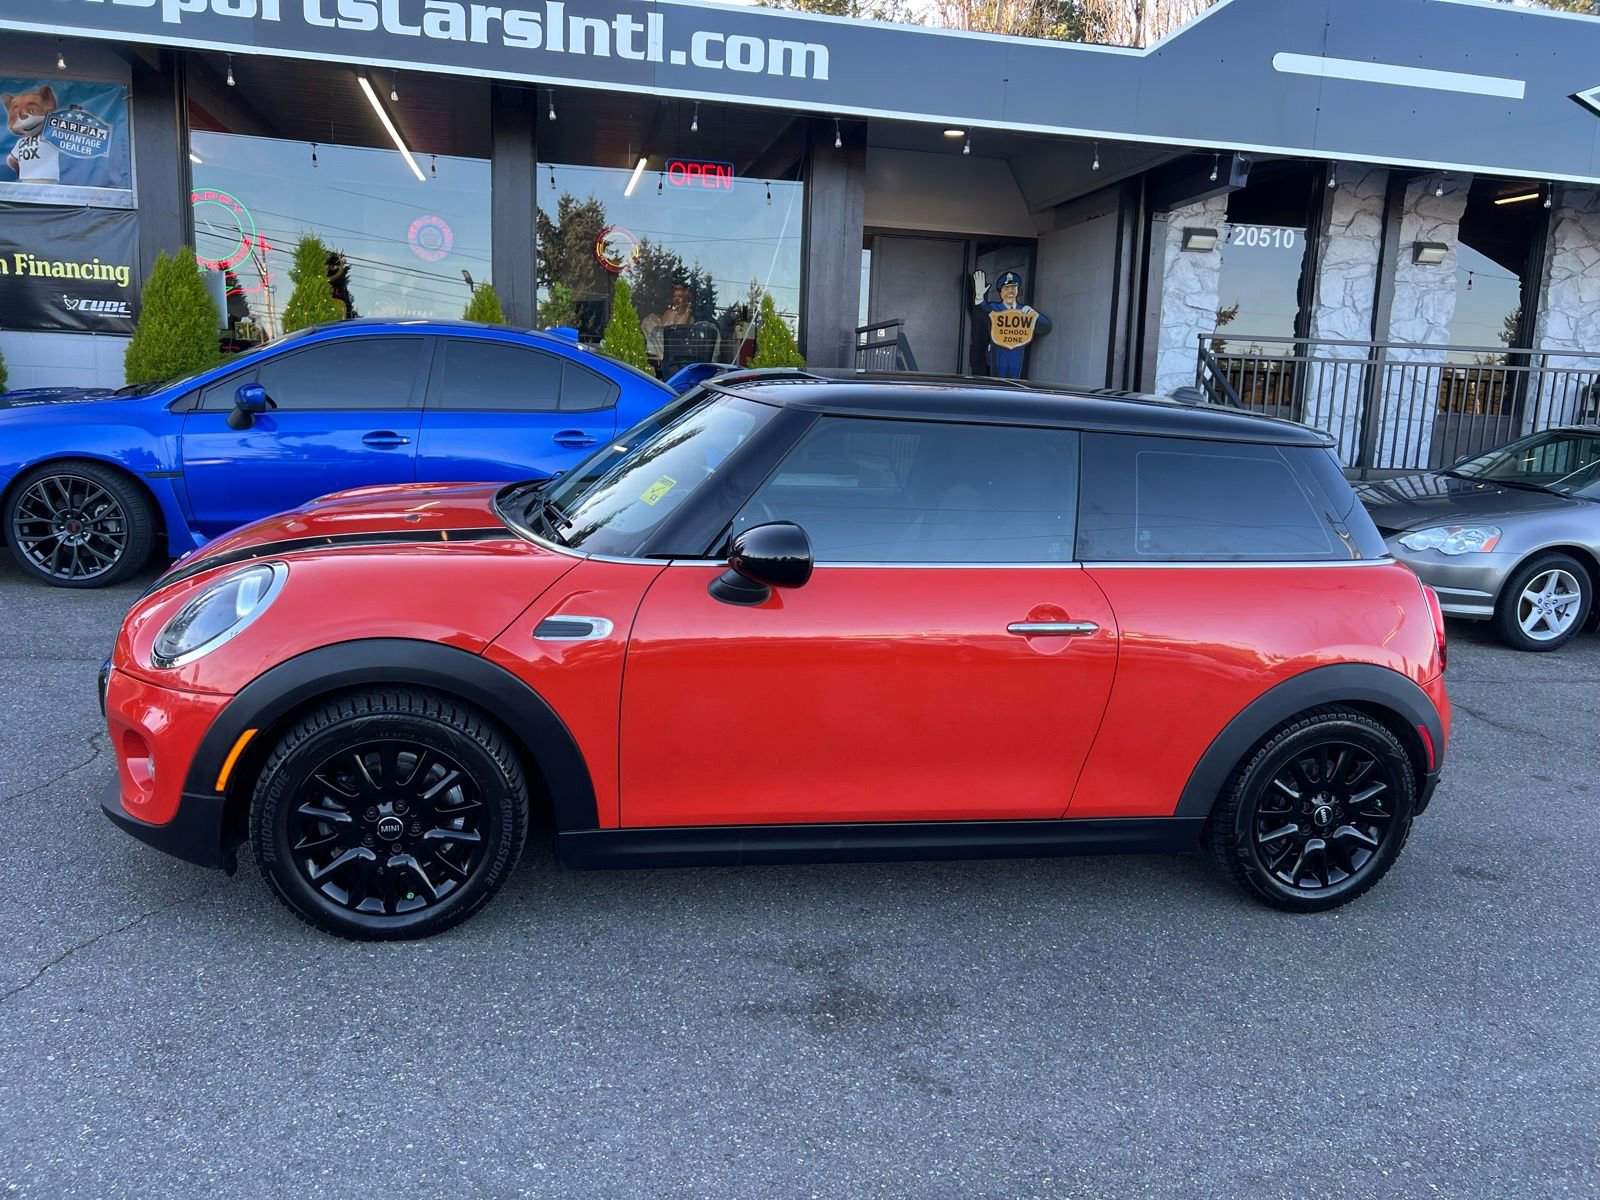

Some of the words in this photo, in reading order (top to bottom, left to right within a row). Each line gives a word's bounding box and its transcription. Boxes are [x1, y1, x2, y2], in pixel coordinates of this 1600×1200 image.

[50, 118, 107, 140] CARFAX
[51, 129, 102, 149] ADVANTAGE
[60, 140, 92, 155] DEALER
[669, 161, 732, 189] OPEN
[1233, 226, 1295, 249] 20510
[14, 253, 130, 287] Financing
[996, 315, 1033, 328] SLOW
[380, 824, 400, 832] MINI
